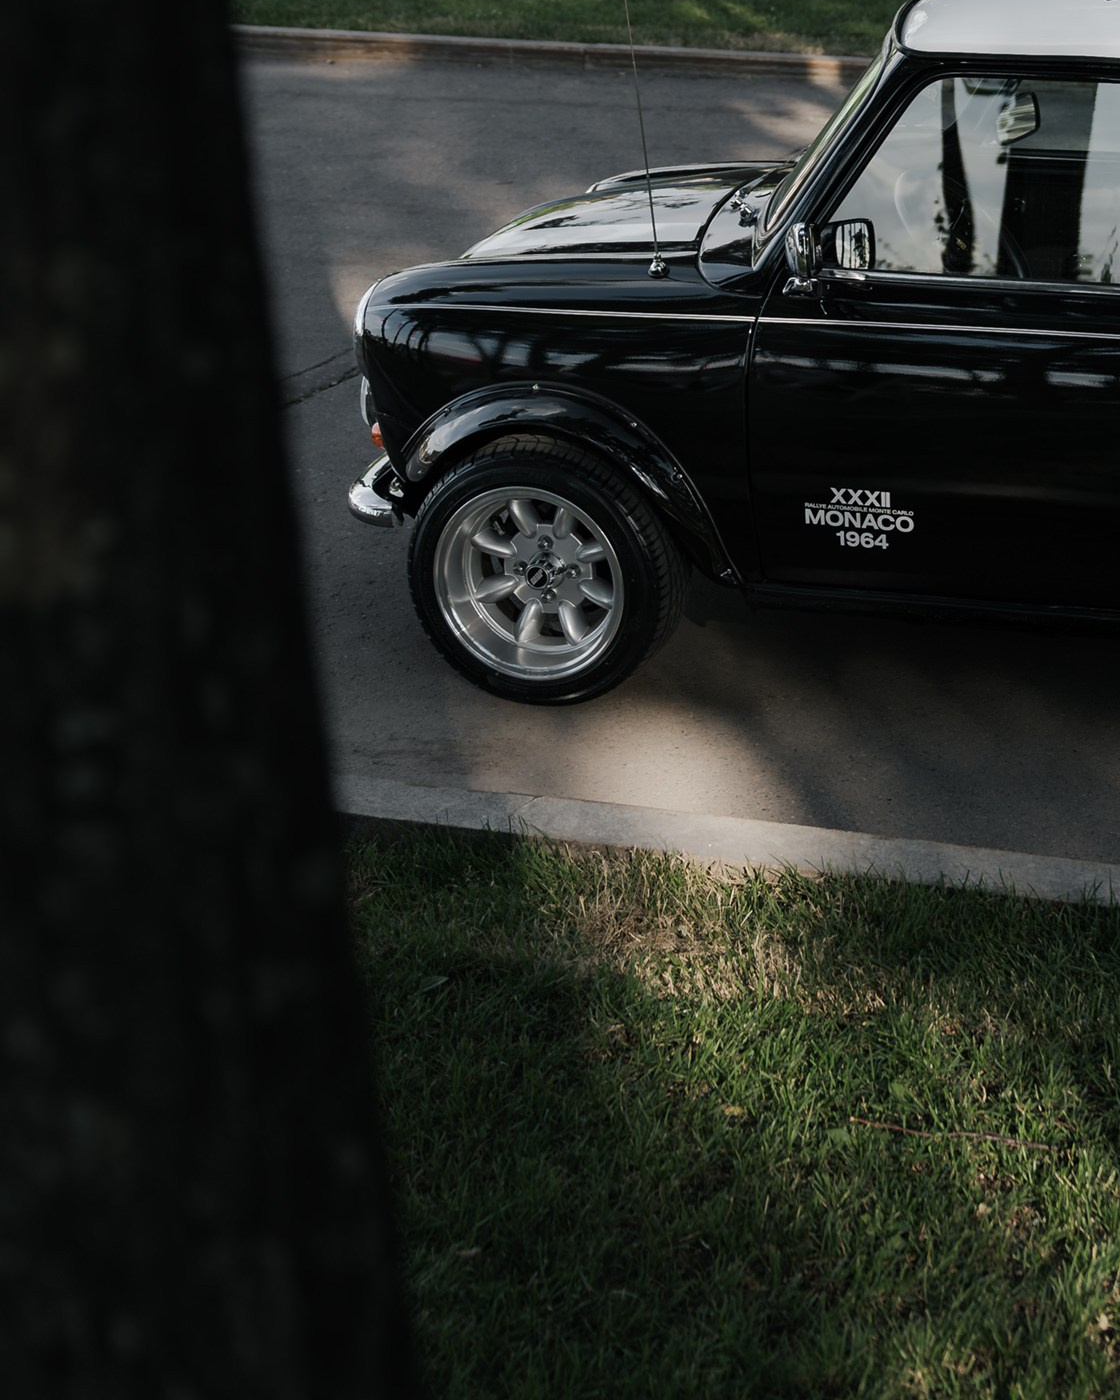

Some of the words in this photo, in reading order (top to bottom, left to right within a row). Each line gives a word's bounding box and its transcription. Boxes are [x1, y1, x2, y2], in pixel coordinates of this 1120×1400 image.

[830, 487, 891, 508] XXXII
[804, 508, 915, 533] MONACO
[827, 504, 868, 513] AUTOMOBILE
[868, 507, 892, 515] MONTE
[892, 509, 914, 517] CARLO
[836, 530, 889, 549] 1964
